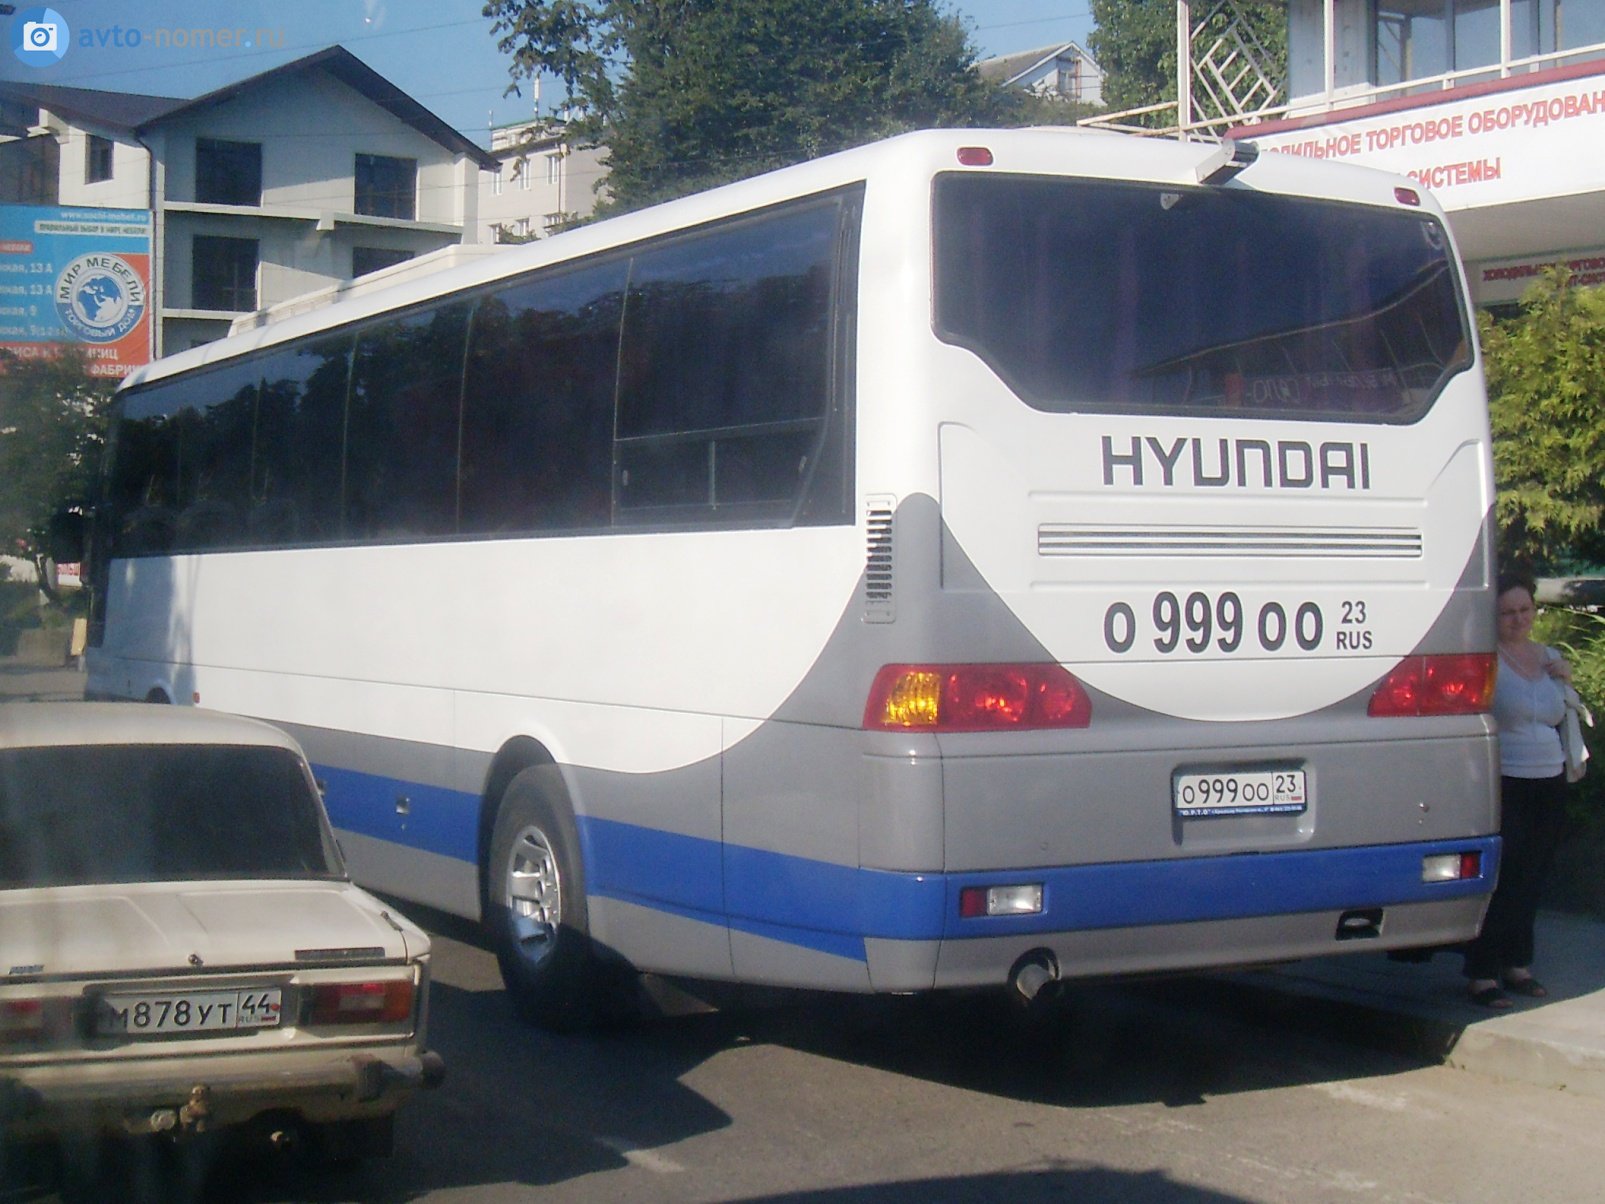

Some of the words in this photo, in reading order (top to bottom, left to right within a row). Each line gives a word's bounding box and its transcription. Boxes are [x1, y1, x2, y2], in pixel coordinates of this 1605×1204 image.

[1366, 116, 1464, 151] ТОРГОВОЕ
[1468, 90, 1605, 132] ОБОРУДОВАН
[60, 264, 82, 299] МИР
[86, 257, 140, 302] МЕБЕЛИ
[1101, 435, 1370, 489] HYUNDAI
[1152, 591, 1243, 653] 999
[1341, 600, 1367, 624] 23
[1336, 630, 1373, 650] RUS
[1275, 775, 1296, 793] 23
[241, 993, 269, 1015] 44
